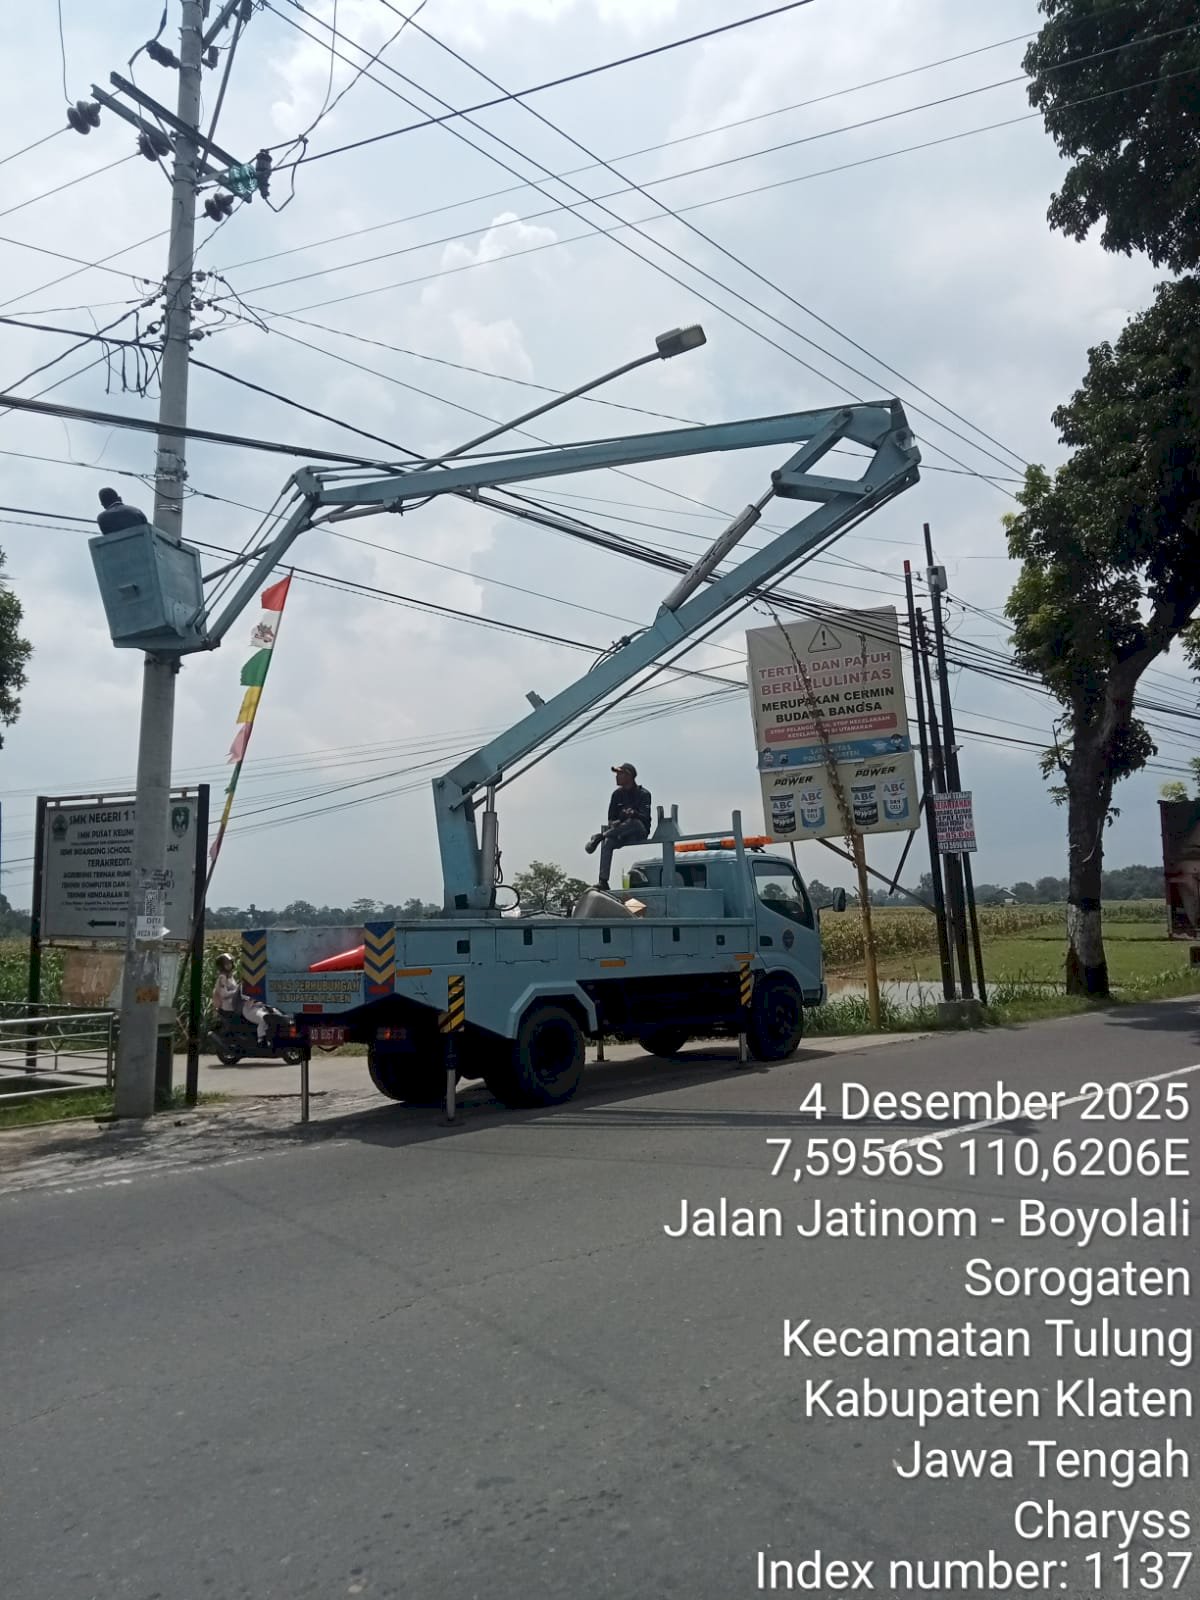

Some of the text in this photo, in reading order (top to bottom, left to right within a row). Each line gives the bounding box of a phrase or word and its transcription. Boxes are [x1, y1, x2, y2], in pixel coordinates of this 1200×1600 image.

[812, 659, 840, 671] DAN
[845, 652, 891, 667] PATUH
[761, 669, 892, 696] BERLLULINTAS
[844, 687, 895, 700] CERMIN
[829, 702, 882, 717] BANGSA
[855, 766, 896, 777] POWER
[774, 775, 814, 787] POWER
[883, 782, 905, 793] ABC
[800, 791, 822, 801] ABC
[854, 791, 874, 801] ABC
[773, 800, 792, 810] ABC
[69, 814, 87, 825] SMK
[89, 811, 121, 823] NEGERI
[123, 810, 129, 821] 1
[92, 829, 111, 838] PUSAT
[107, 846, 132, 854] SCHOOL
[294, 980, 360, 992] PERHUBUNGAN
